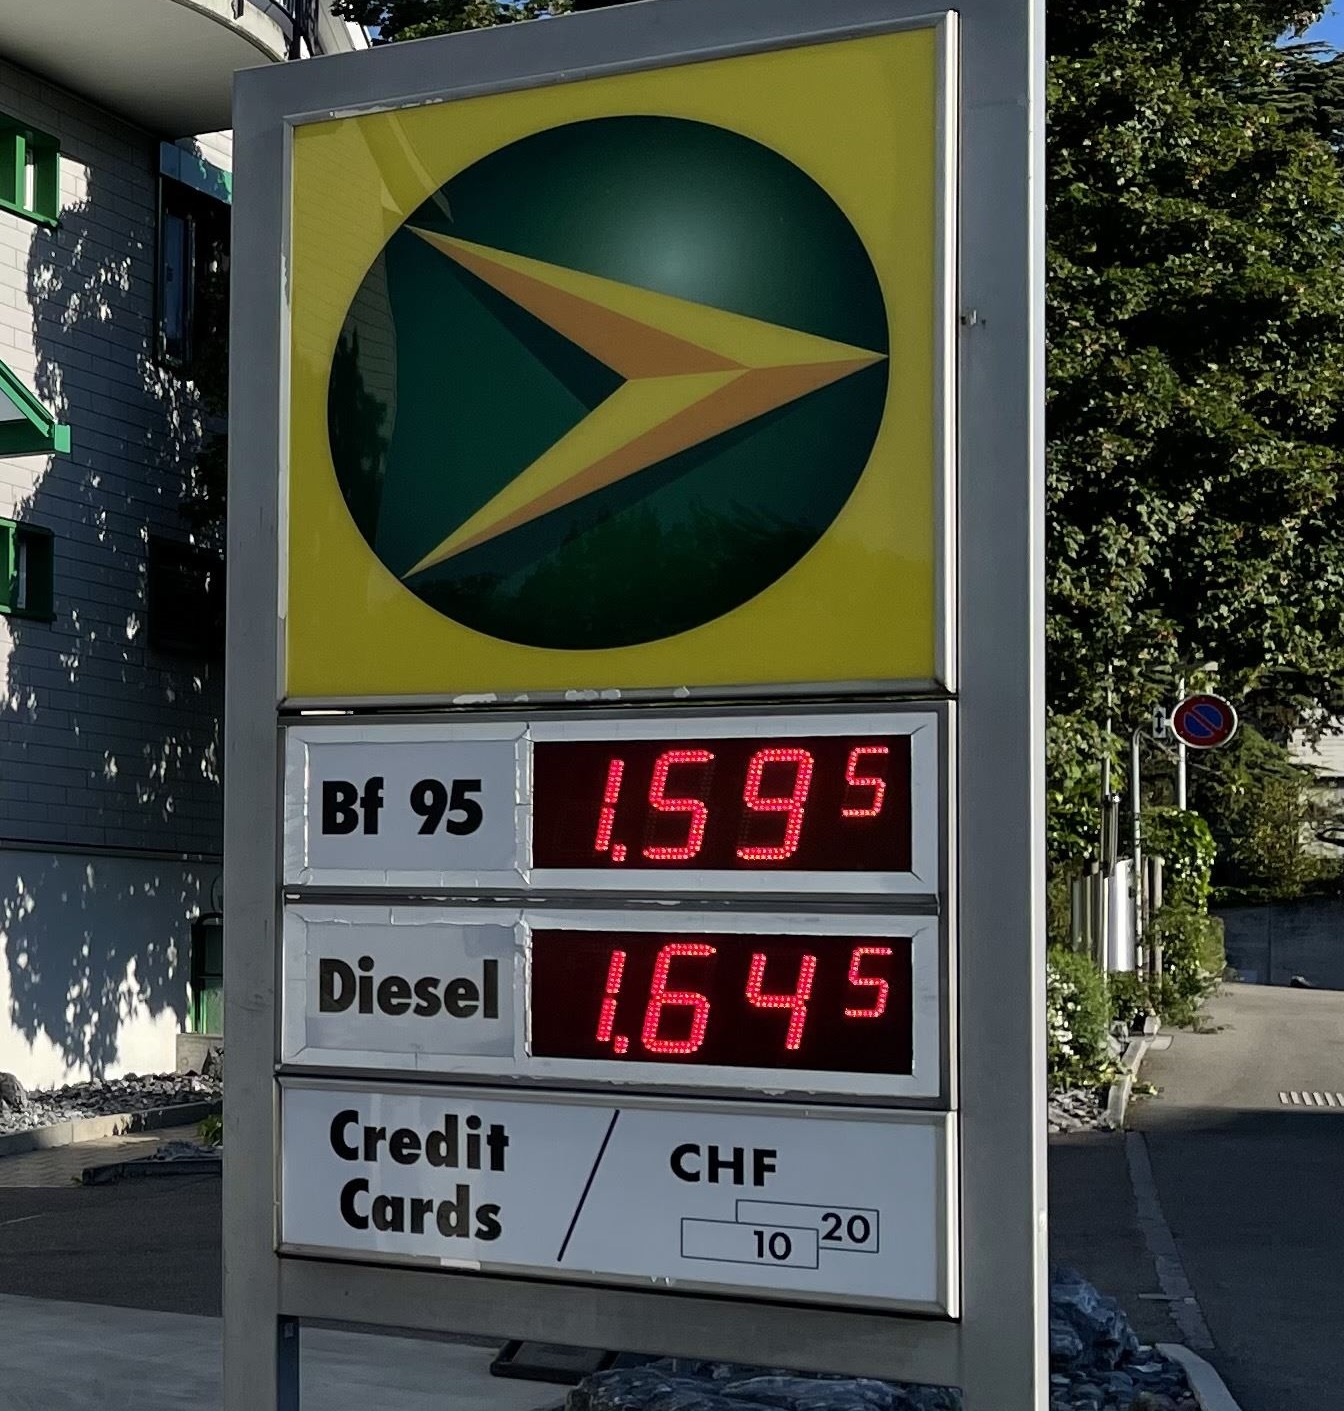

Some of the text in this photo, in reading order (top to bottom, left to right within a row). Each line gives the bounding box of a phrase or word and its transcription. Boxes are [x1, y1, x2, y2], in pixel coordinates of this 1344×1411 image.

[321, 776, 484, 836] Bf 95
[318, 955, 500, 1021] Diesel
[328, 1109, 511, 1173] Credit
[669, 1143, 778, 1187] CHF
[339, 1177, 503, 1242] Cards
[820, 1211, 872, 1245] 20
[752, 1229, 793, 1261] 10
